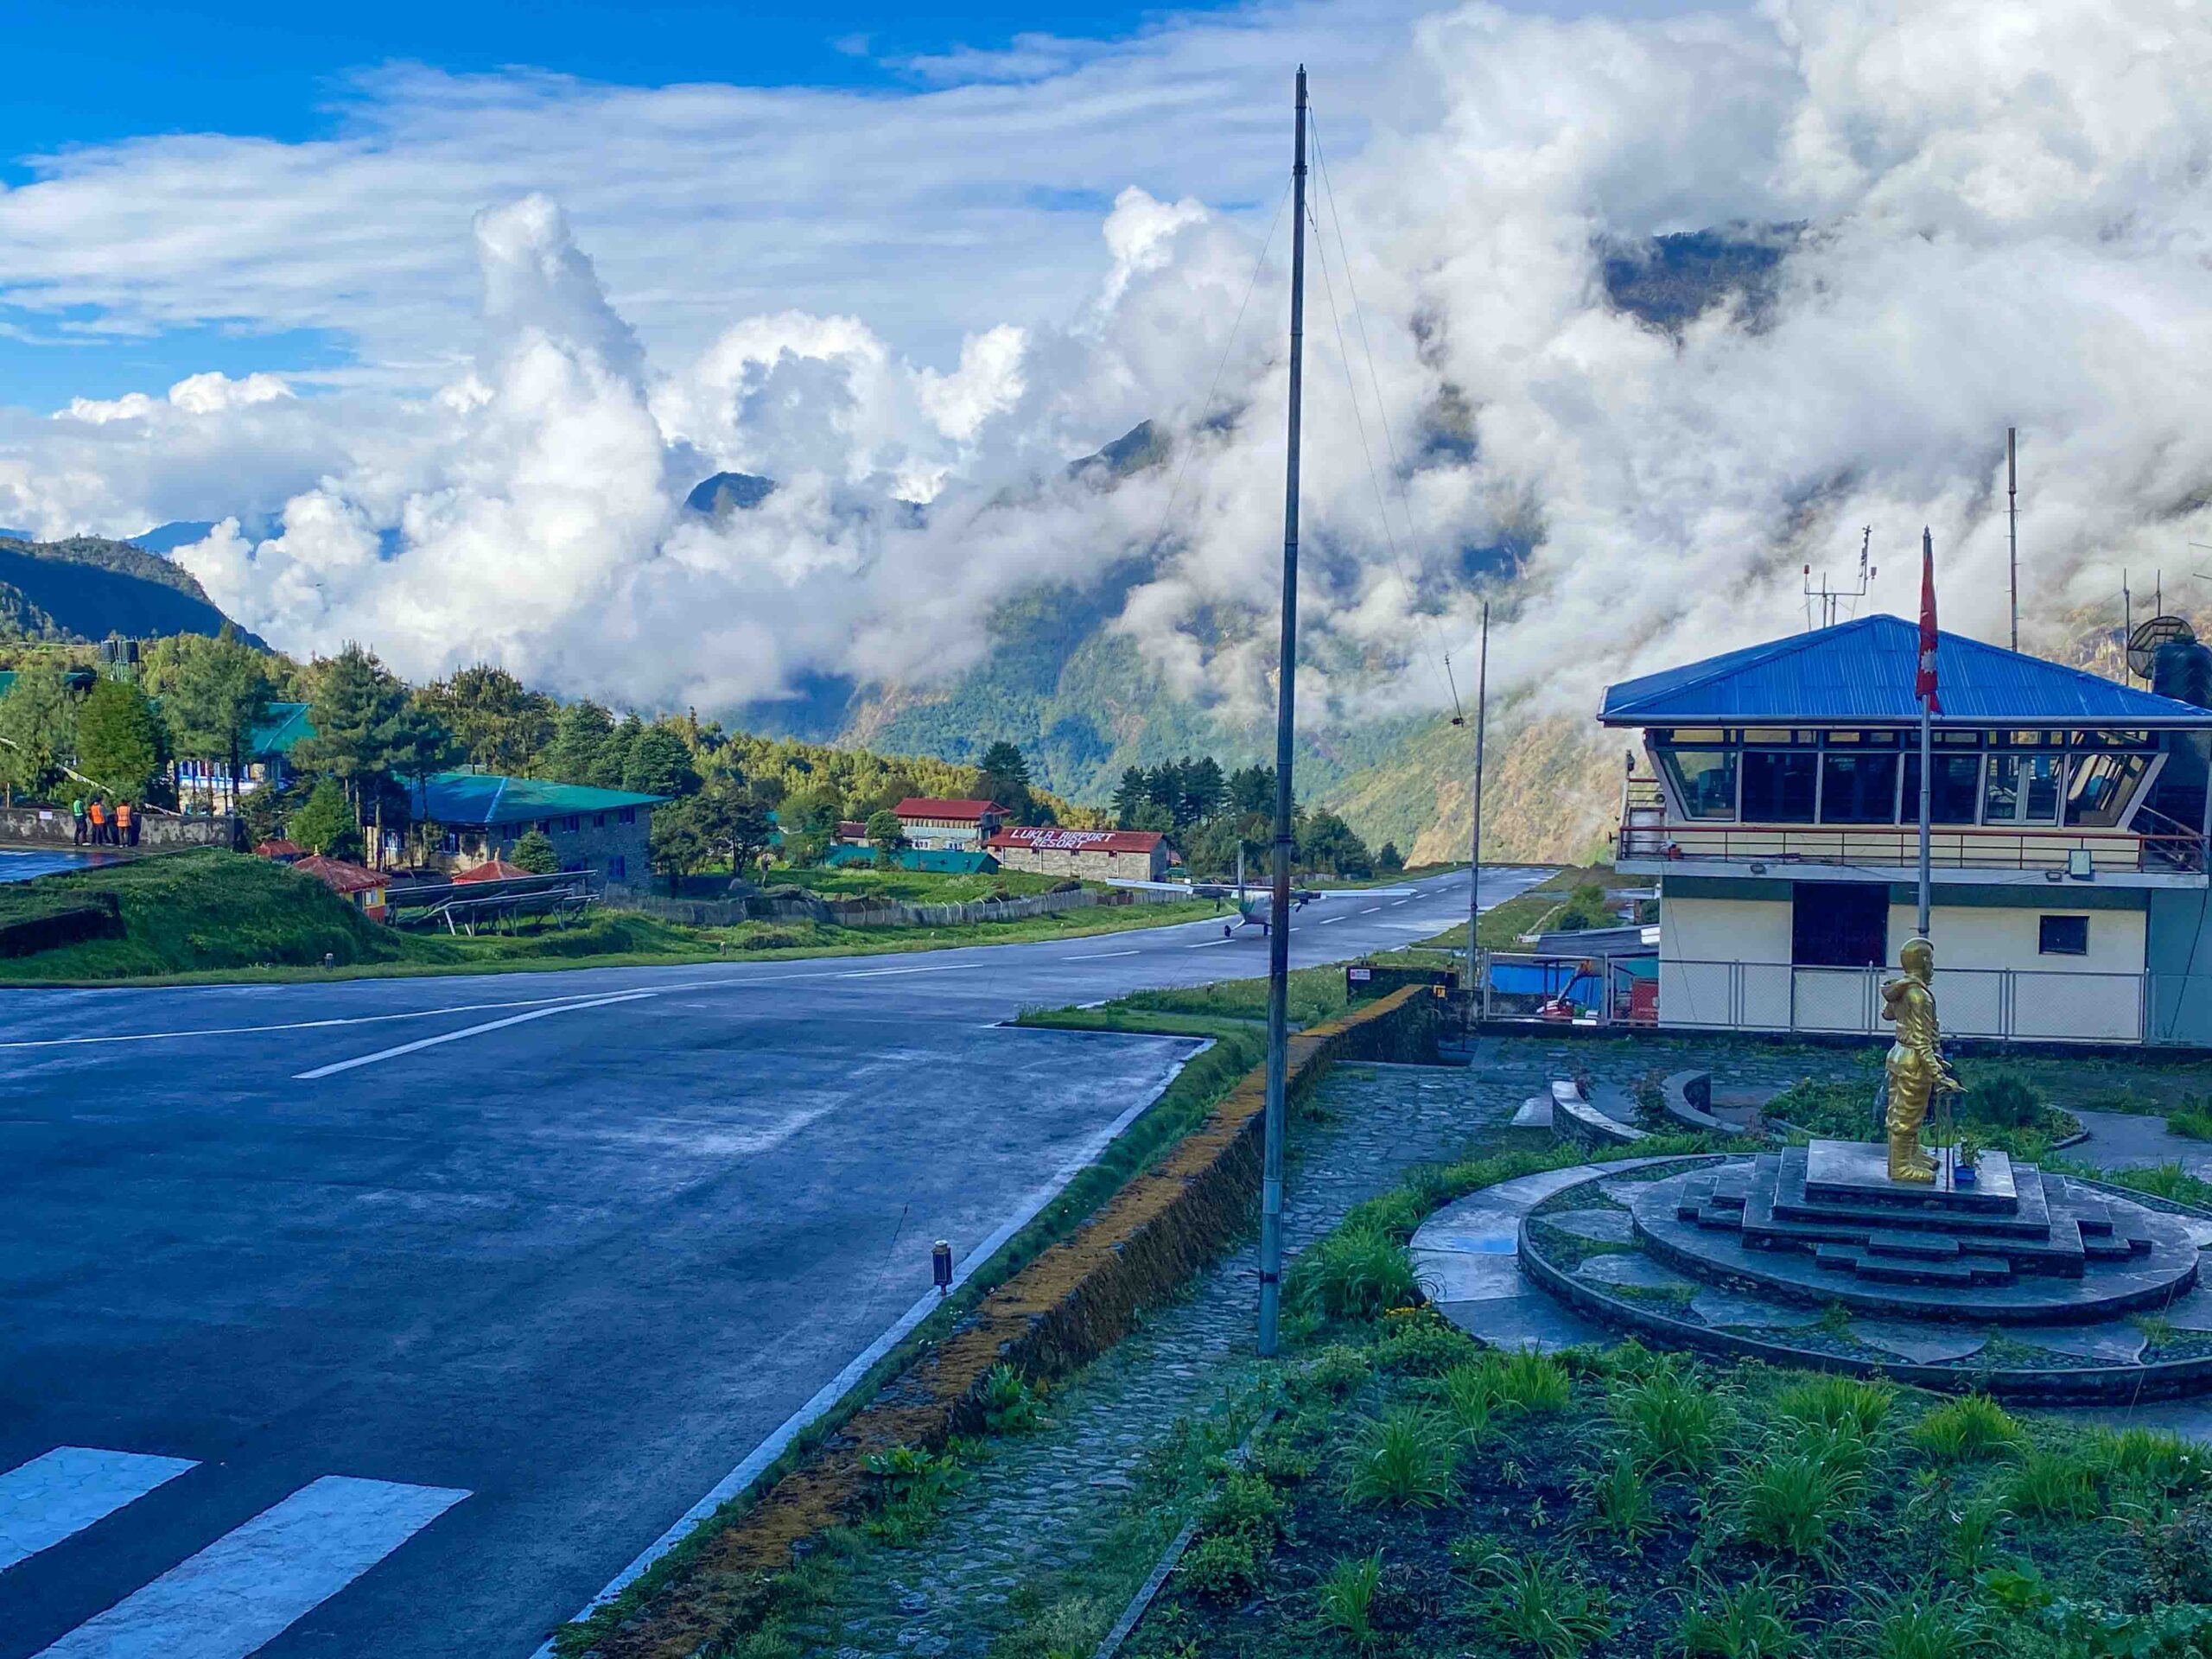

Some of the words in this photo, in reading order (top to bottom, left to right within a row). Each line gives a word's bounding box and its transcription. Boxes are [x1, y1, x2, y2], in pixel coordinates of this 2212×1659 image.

[1010, 829, 1055, 841] LUKLA
[1058, 831, 1116, 842] AIRPORT
[1030, 837, 1087, 849] RESORT
